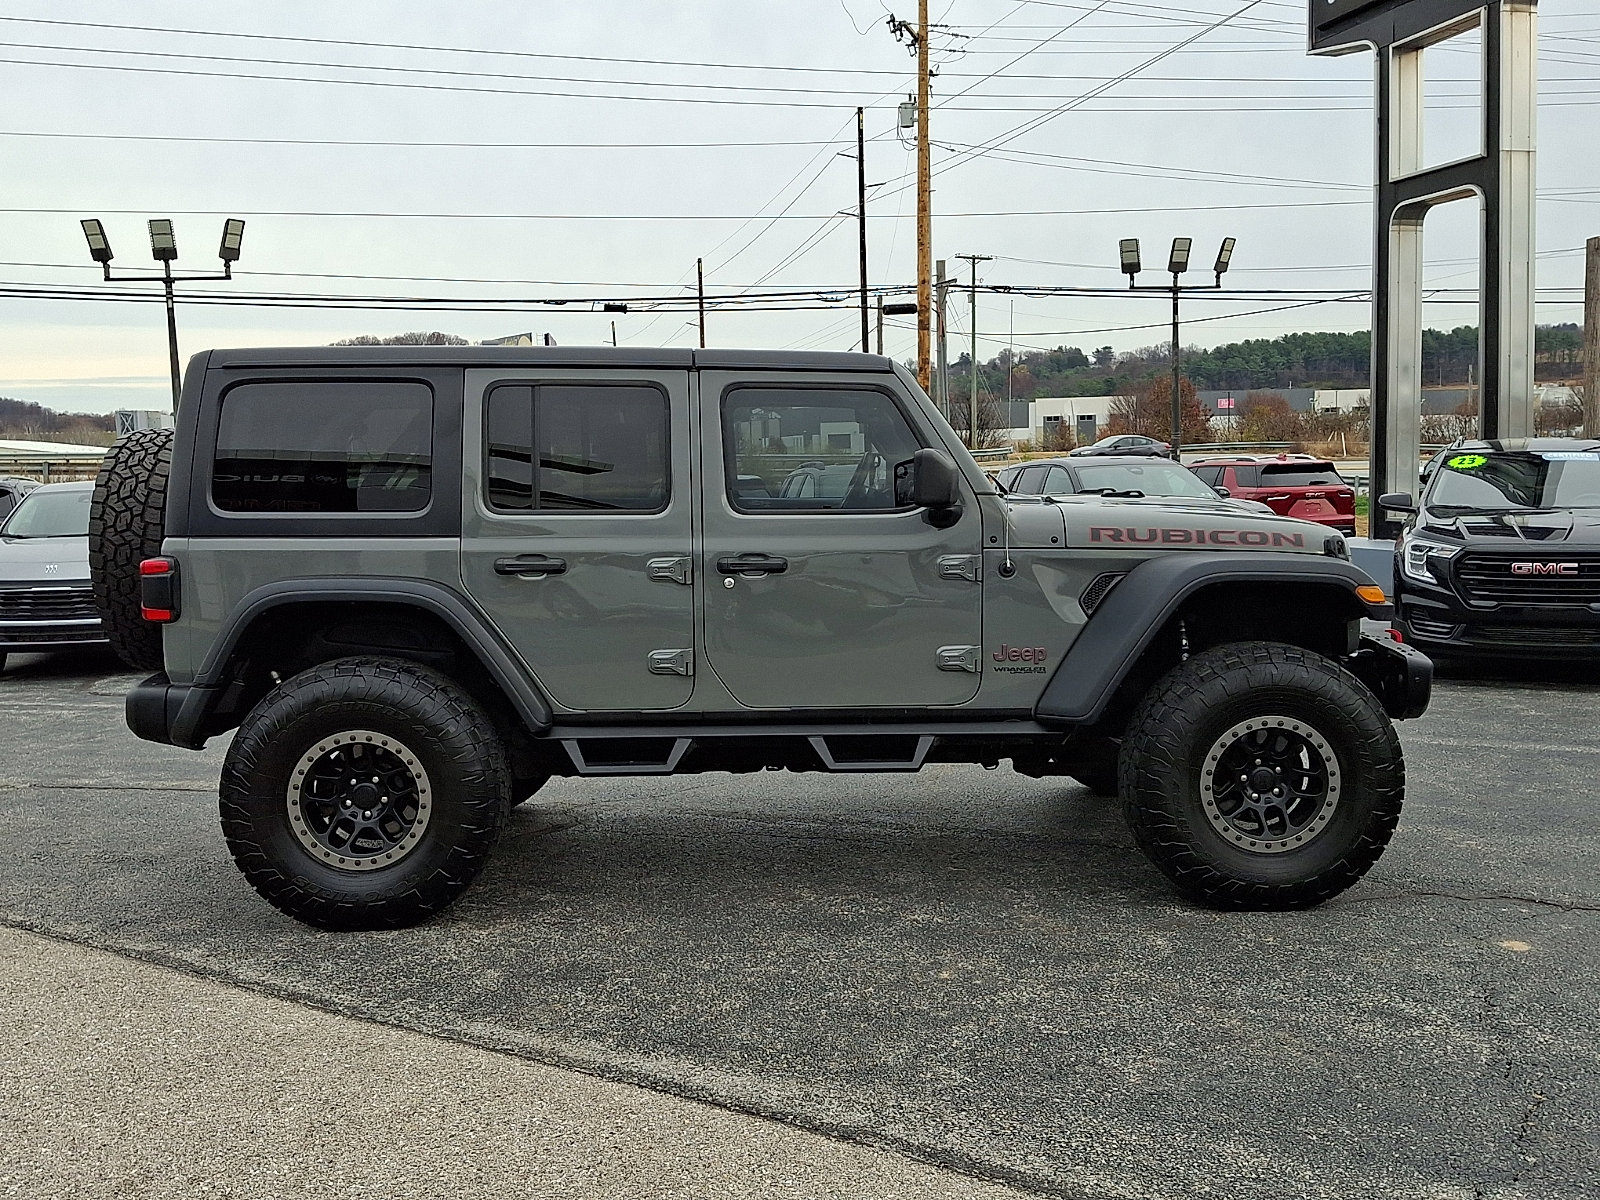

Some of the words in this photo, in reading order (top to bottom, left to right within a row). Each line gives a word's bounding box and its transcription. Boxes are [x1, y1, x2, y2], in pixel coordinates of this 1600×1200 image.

[1457, 457, 1477, 465] 23
[1546, 452, 1593, 460] CERTIFIED
[1089, 527, 1304, 547] RUBICON
[1511, 562, 1579, 575] GMC
[992, 643, 1048, 665] Jeep
